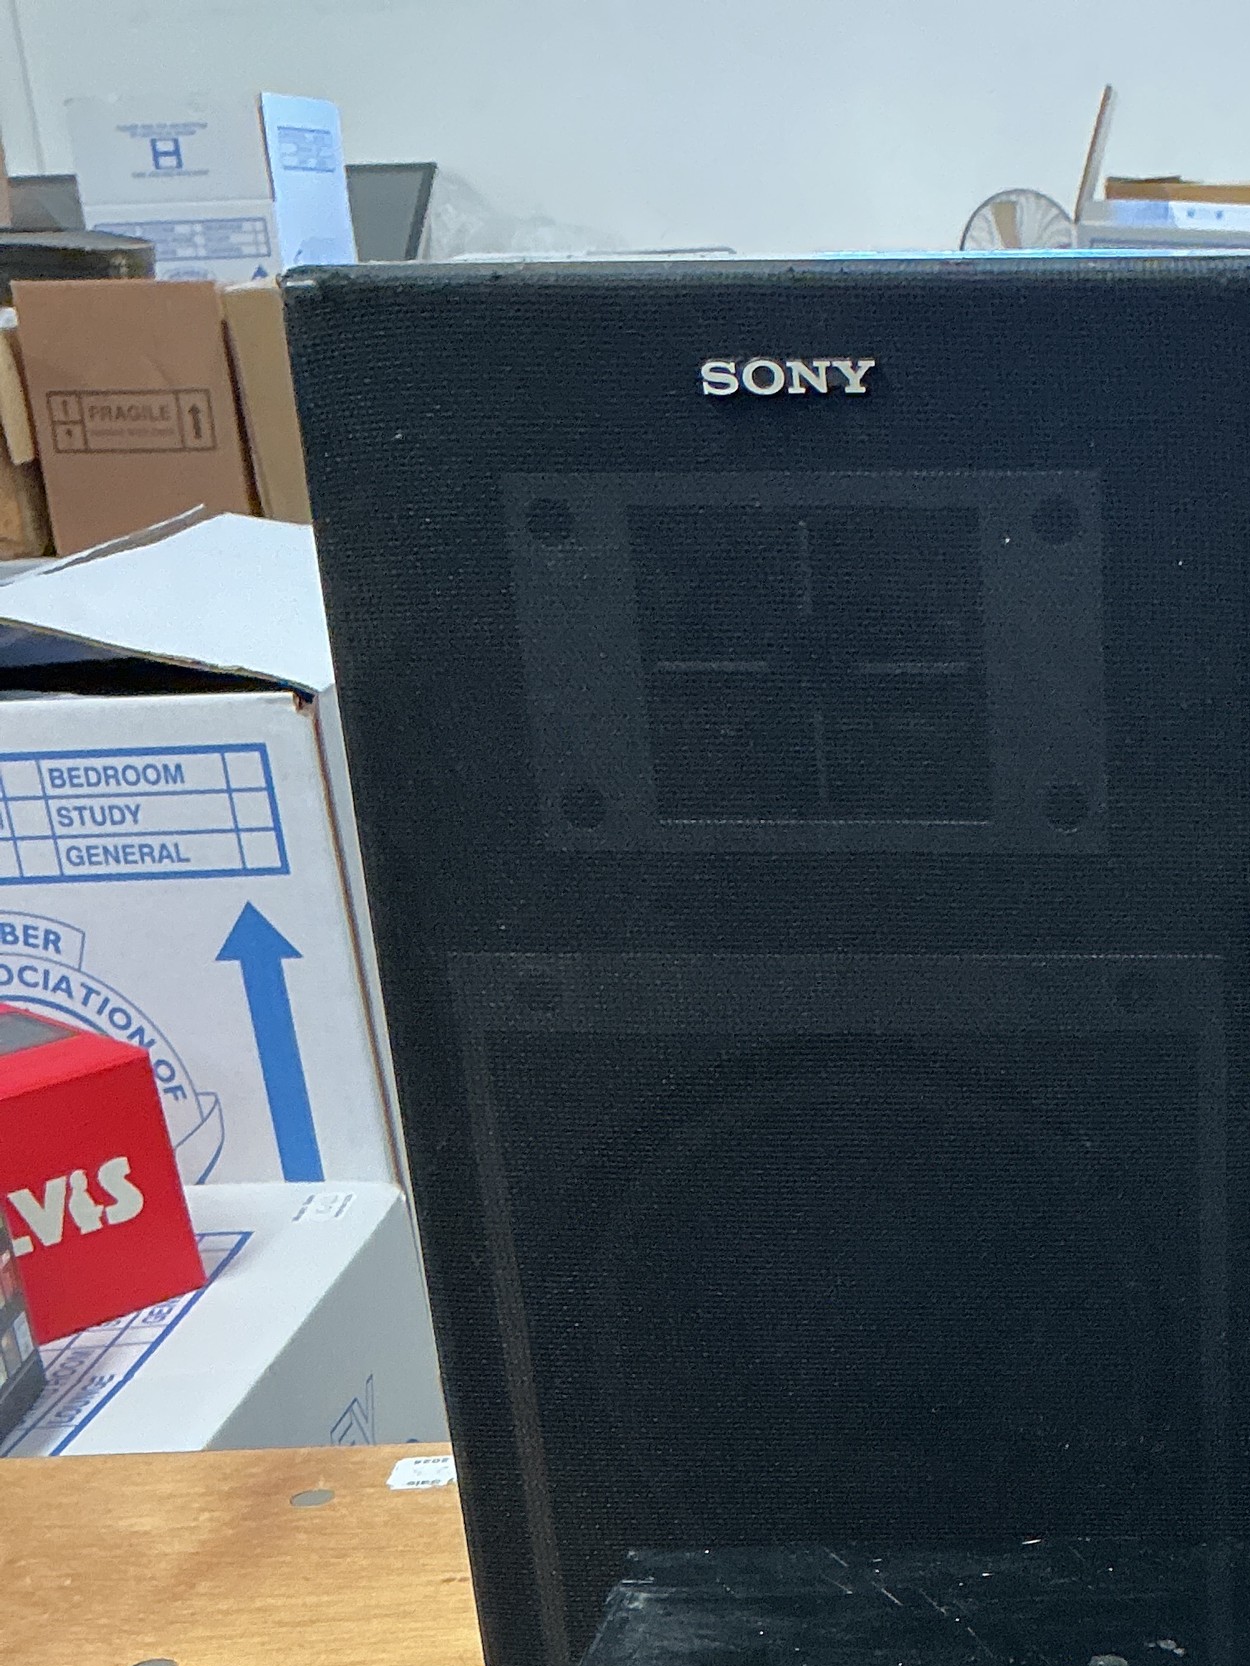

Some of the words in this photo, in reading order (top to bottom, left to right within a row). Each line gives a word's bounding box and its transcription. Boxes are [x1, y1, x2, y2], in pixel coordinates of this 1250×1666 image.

[700, 358, 875, 395] SONY
[88, 404, 172, 421] FRAGILE
[48, 762, 186, 789] BEDROOM
[56, 804, 141, 827] STUDY
[65, 842, 191, 867] GENERAL
[153, 1058, 188, 1102] OF
